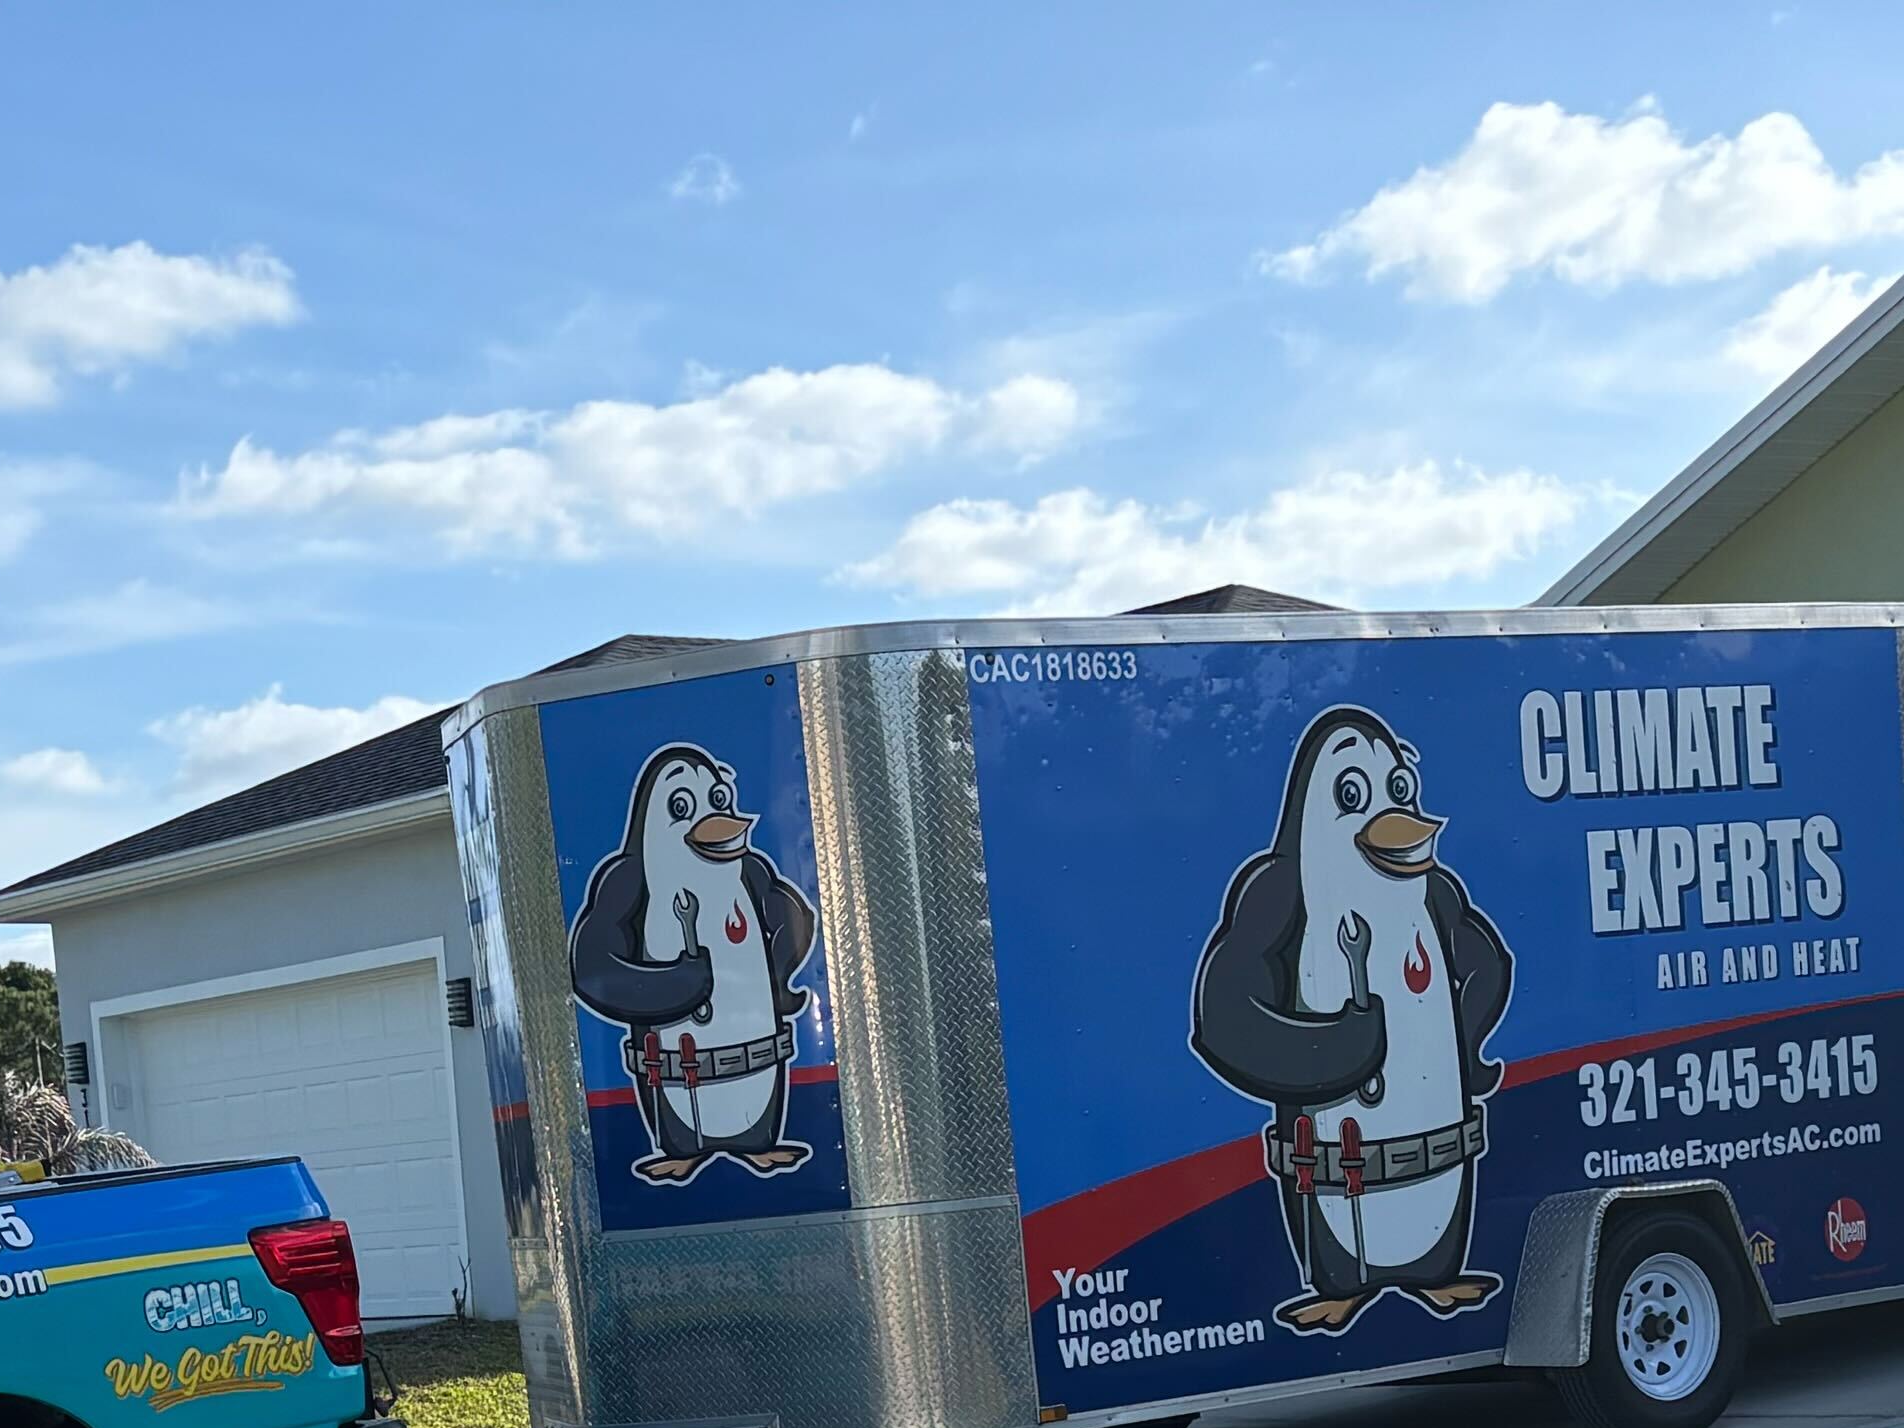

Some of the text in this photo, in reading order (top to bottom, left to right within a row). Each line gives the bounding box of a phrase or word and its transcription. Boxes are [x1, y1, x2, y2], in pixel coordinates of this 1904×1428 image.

[969, 651, 1137, 683] CAC1818633
[1519, 684, 1779, 800] CLIMATE
[1586, 814, 1844, 934] EXPERTS
[1657, 937, 1860, 990] AIR AND HEAT
[1578, 1034, 1878, 1127] 321-345-3415
[1583, 1122, 1881, 1179] ClimateExpertsAC.com
[1827, 1199, 1866, 1253] Rheem
[1749, 1242, 1775, 1265] ATE
[145, 1278, 267, 1332] CHILL,
[1052, 1268, 1129, 1299] Your
[1056, 1298, 1163, 1334] Indoor
[105, 1331, 316, 1398] We Got This!
[1057, 1319, 1265, 1369] Weathermen
